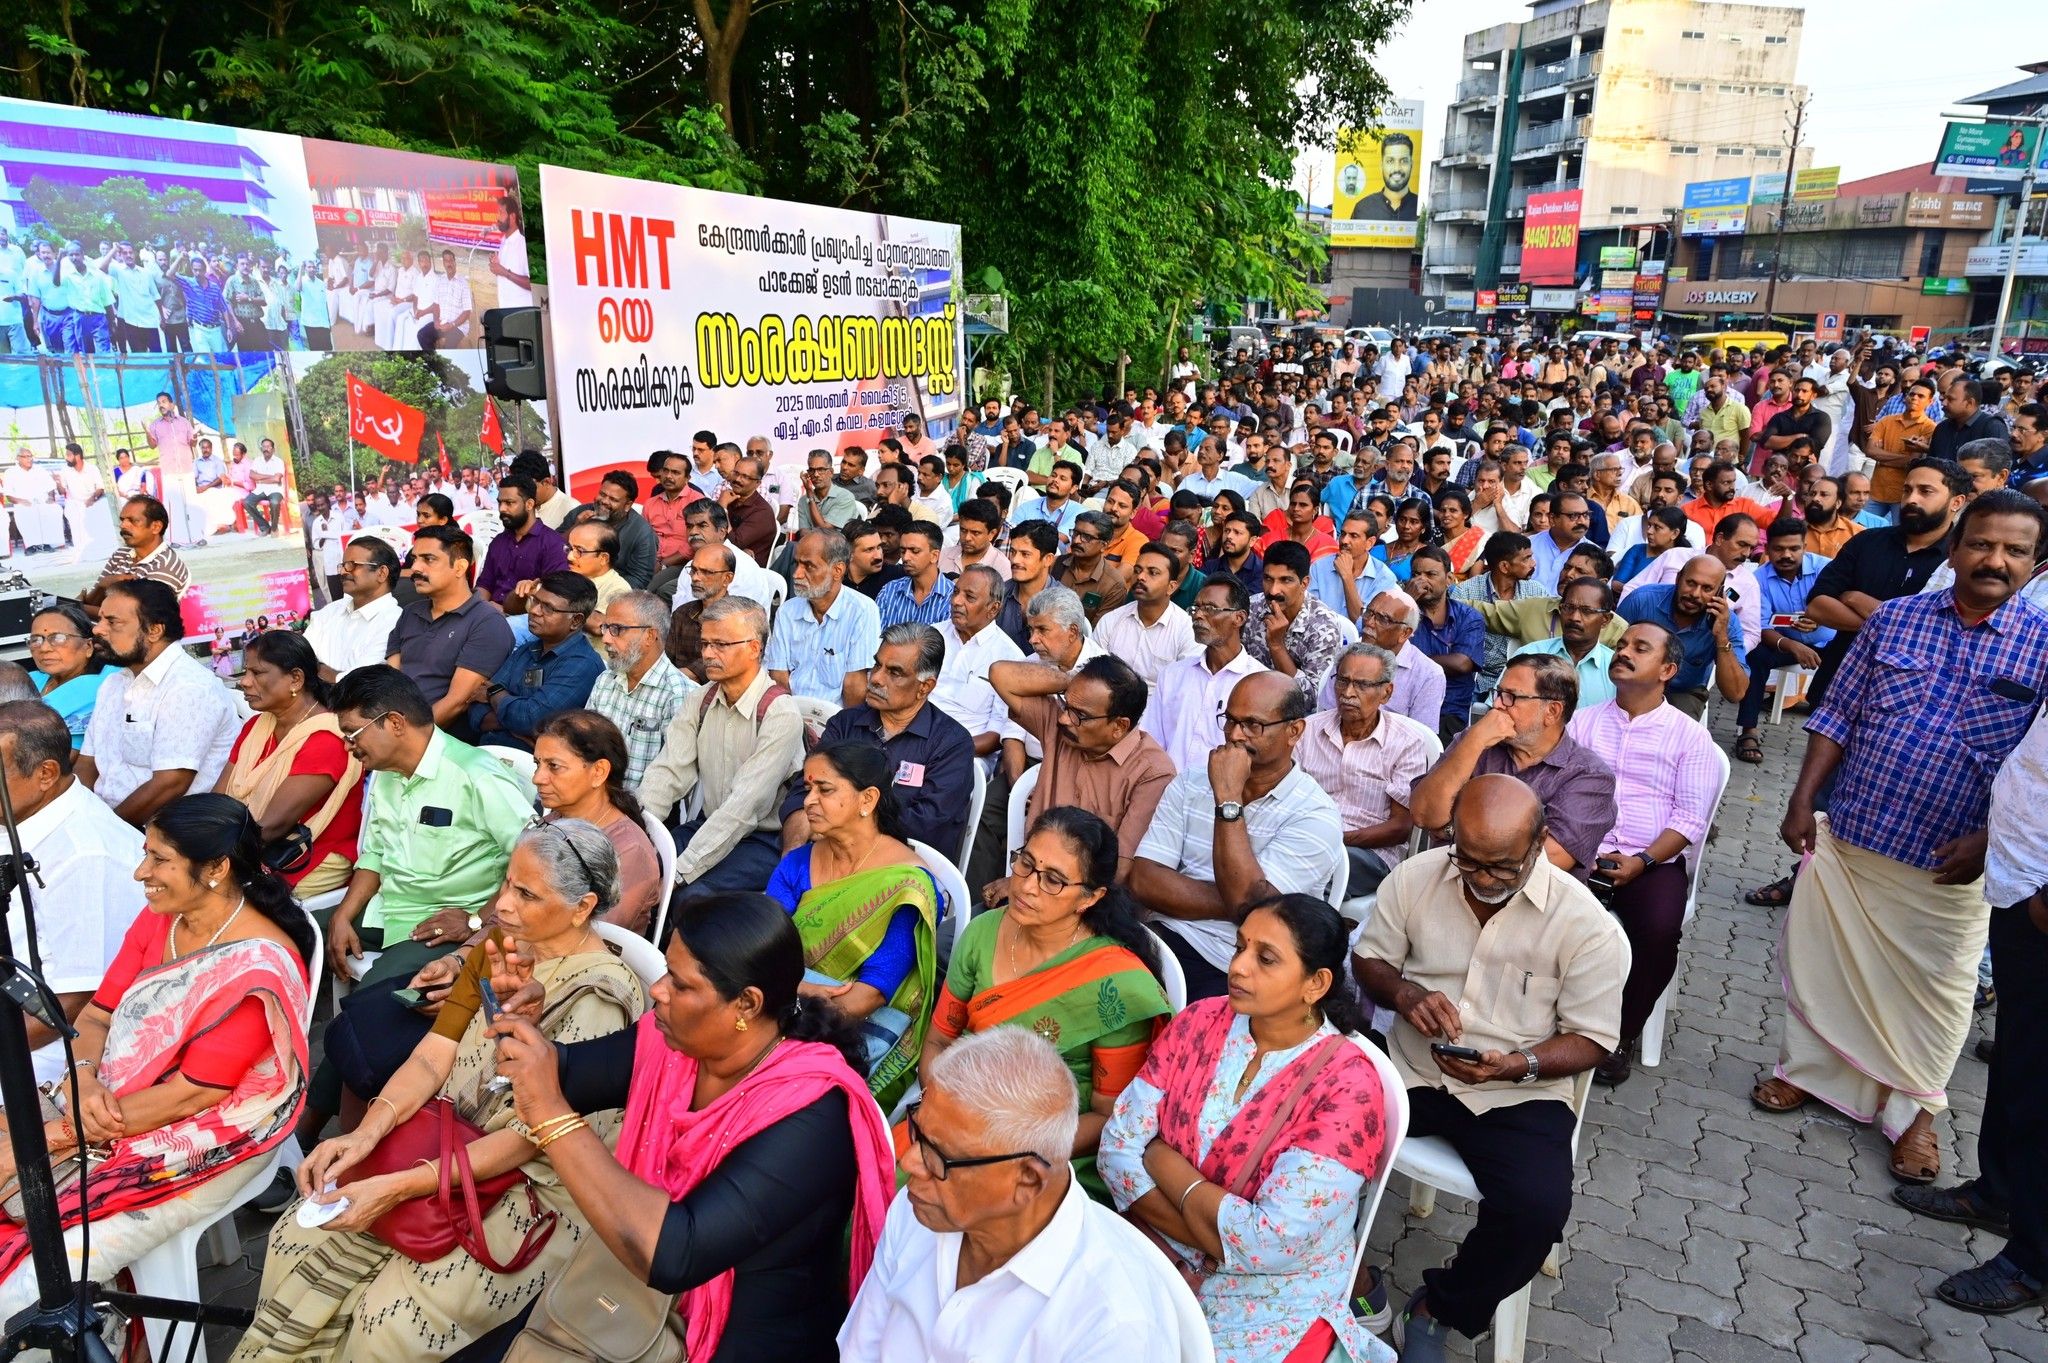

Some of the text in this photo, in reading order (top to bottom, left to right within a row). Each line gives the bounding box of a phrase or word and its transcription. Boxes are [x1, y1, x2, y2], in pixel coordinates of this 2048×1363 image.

[1385, 107, 1415, 117] CRAFT
[1958, 127, 1967, 135] No
[1527, 201, 1579, 216] Rajan Outdoor Media
[1966, 201, 1983, 211] FACE
[571, 209, 675, 290] HMT
[698, 223, 951, 271] കേന്ദ്രസർക്കാർ പ്രഖ്യാപിച്ച പുനരുദ്ധാരണ
[1523, 223, 1577, 250] 94460 32461
[759, 267, 919, 302] പാക്കേജ് ഉടൻ നടപ്പാക്കുക
[1511, 293, 1527, 301] FOOD
[1684, 291, 1757, 304] JOS BAKERY
[598, 297, 654, 343] യെ
[576, 353, 694, 420] സംരക്ഷിക്കുക
[776, 394, 803, 413] 2025
[806, 389, 848, 411] നവംബർ
[851, 391, 858, 408] 7
[860, 386, 900, 407] വൈകീട്ട്
[353, 384, 365, 434] CITU
[836, 415, 862, 431] കവല
